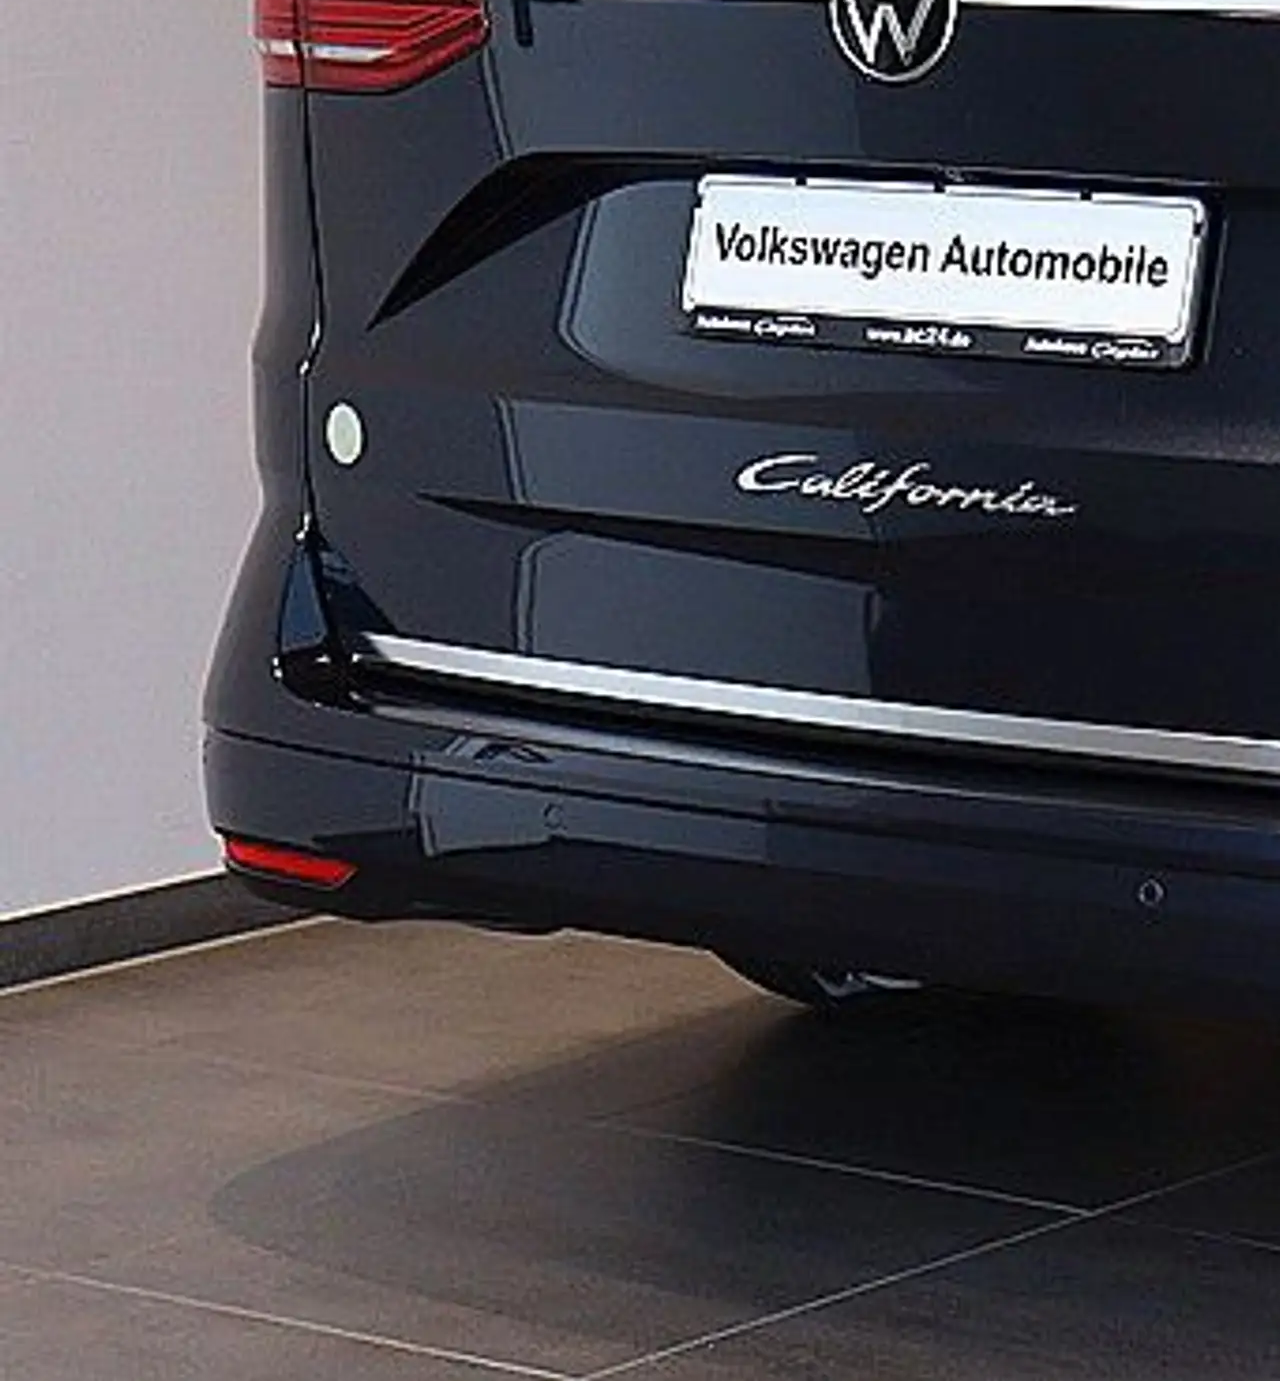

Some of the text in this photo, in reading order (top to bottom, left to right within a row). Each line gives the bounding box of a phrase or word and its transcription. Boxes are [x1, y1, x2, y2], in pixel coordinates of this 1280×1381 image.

[715, 222, 1169, 287] Volkswagen Automobile
[736, 454, 1076, 514] California
